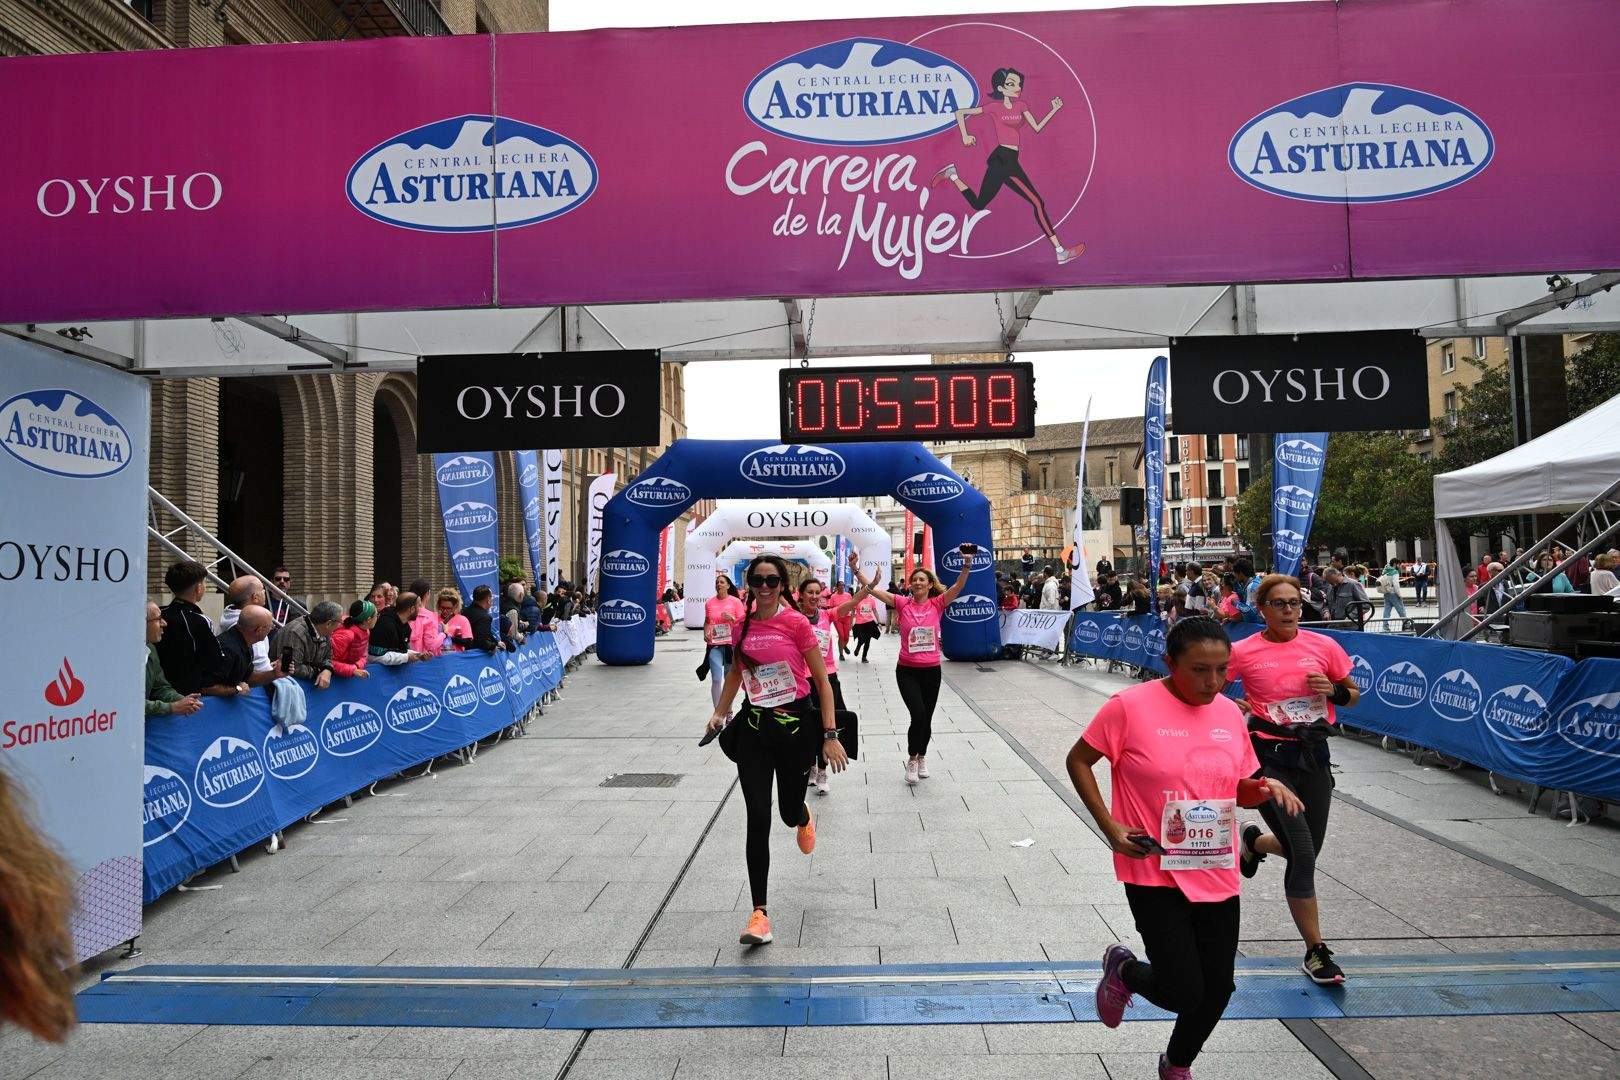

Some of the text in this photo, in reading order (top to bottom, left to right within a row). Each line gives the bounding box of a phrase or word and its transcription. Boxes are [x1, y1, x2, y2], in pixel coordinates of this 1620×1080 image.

[798, 73, 953, 87] CENTRAL LECHERA
[762, 80, 961, 120] ASTURIANA
[1289, 120, 1464, 139] CENTRAL LECHERA
[404, 152, 570, 170] CENTRAL LECHERA
[1250, 131, 1475, 174] ASTURIANA
[725, 141, 918, 195] Carrera
[37, 172, 223, 217] OYSHO
[365, 162, 579, 204] ASTURIANA
[773, 187, 992, 280] de la Mujer
[1212, 365, 1391, 405] OYSHO
[456, 383, 626, 420] OYSHO
[5, 410, 123, 464] ASTURIANA
[29, 412, 120, 439] CENTRAL LECHERA
[748, 458, 838, 476] ASTURIANA
[1182, 440, 1190, 481] HOTEL
[630, 488, 686, 500] ASTURIANA
[902, 485, 960, 496] ASTURIANA
[747, 510, 828, 528] OYSHO
[0, 541, 130, 582] OYSHO
[602, 562, 646, 572] ASTURIANA
[600, 608, 642, 620] ASTURIANA
[948, 606, 994, 617] ASTURIANA
[1018, 613, 1056, 630] OYSHO
[762, 679, 778, 688] 016
[1379, 675, 1422, 699] ASTURIANA
[448, 690, 477, 710] ASTURIANA
[1432, 684, 1476, 712] ASTURIANA
[392, 702, 438, 726] ASTURIANA
[2, 709, 118, 749] Santander
[326, 720, 380, 748] ASTURIANA
[210, 751, 254, 772] CENTRAL LECHERA
[268, 742, 316, 770] ASTURIANA
[203, 760, 262, 798] ASTURIANA
[1188, 828, 1214, 838] 016
